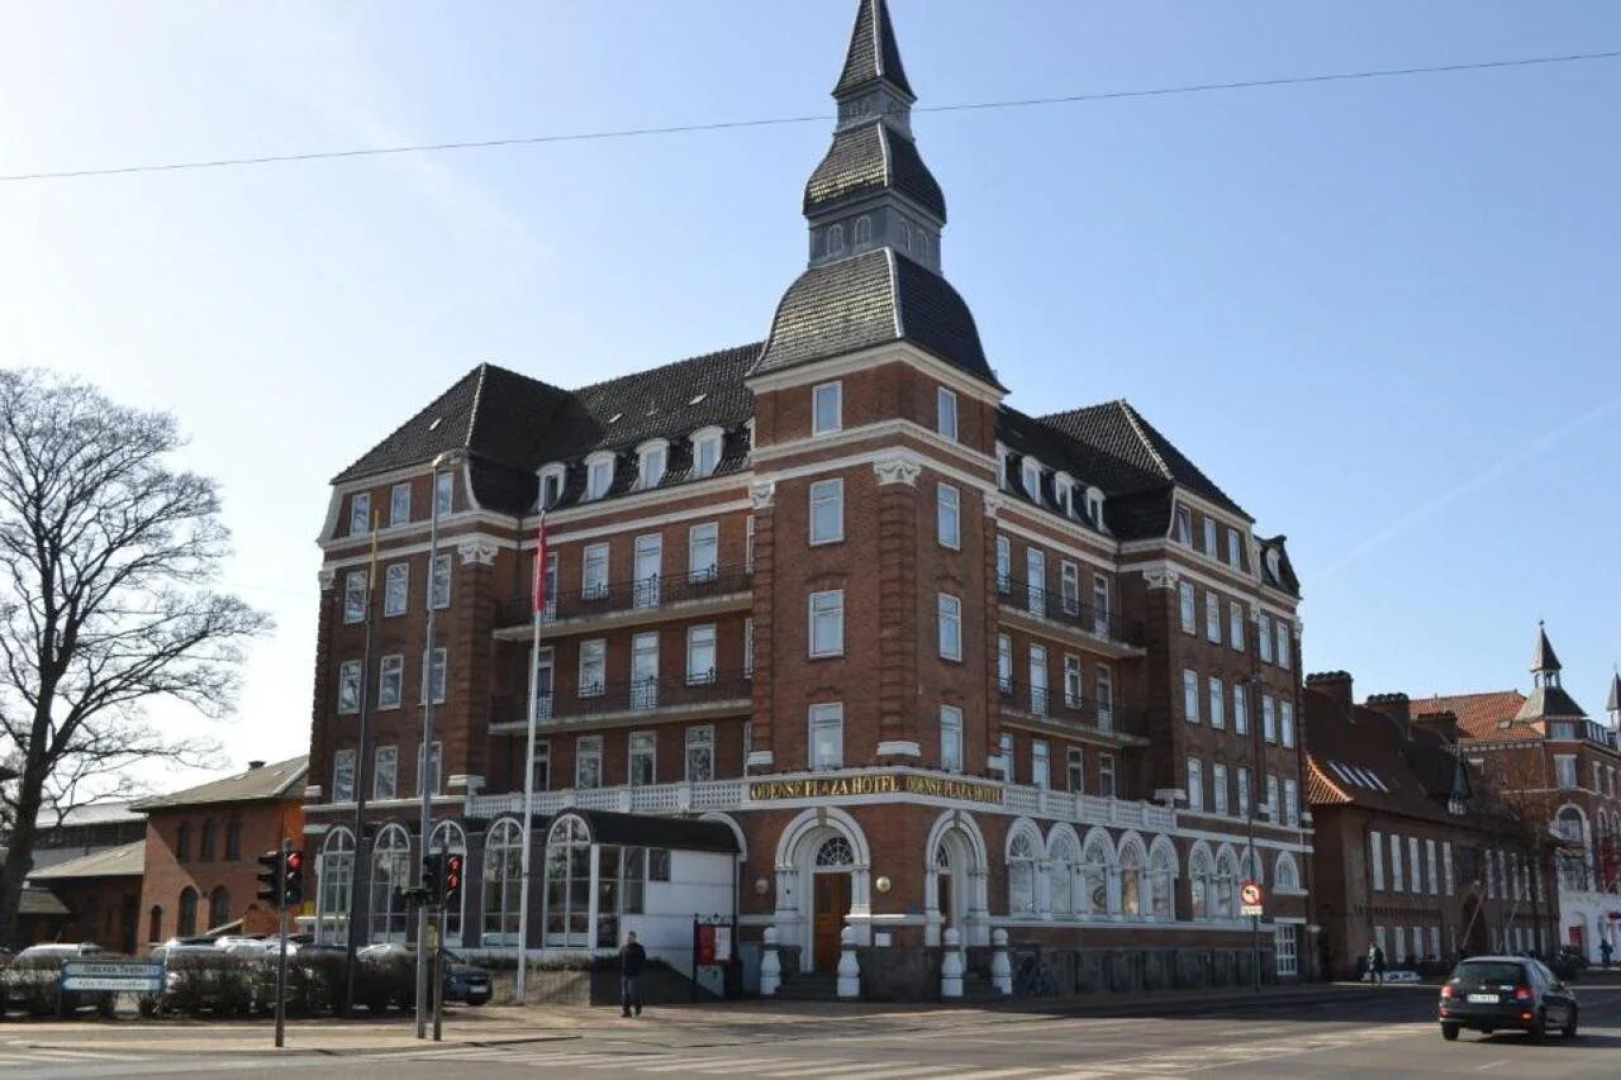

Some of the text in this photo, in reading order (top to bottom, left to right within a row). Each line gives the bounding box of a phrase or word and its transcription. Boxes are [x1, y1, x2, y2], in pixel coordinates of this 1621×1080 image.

[751, 774, 899, 800] ODENSE PLAZA HOTEL
